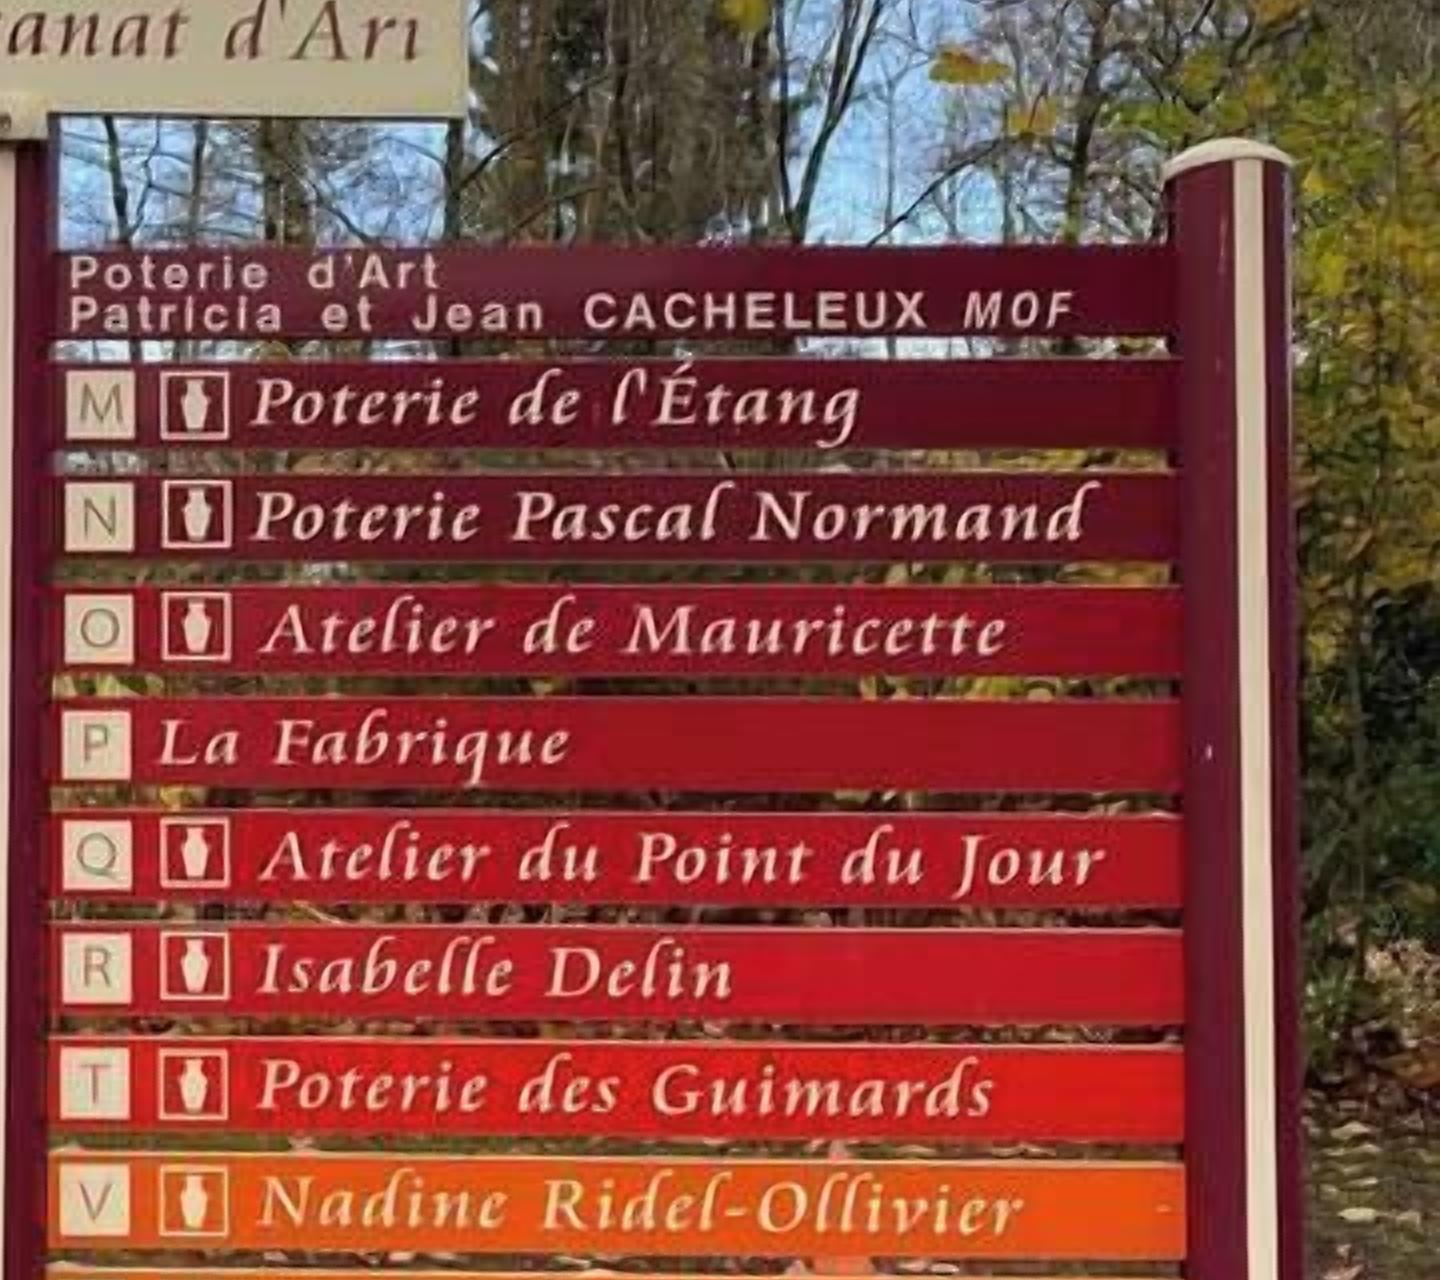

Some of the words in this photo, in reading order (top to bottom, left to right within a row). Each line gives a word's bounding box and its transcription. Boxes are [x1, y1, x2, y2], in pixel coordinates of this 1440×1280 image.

[70, 257, 270, 290] Poterie
[308, 256, 439, 290] d'Art
[70, 295, 282, 333] Patricia
[322, 296, 373, 332] et
[413, 294, 543, 333] Jean
[584, 292, 926, 331] CACHELEUX
[964, 290, 1074, 328] MOF
[79, 382, 124, 423] M
[251, 378, 482, 427] Poterie
[509, 368, 581, 426] de
[611, 360, 859, 449] l'Étang
[83, 497, 117, 537] N
[251, 491, 482, 542] Poterie
[513, 482, 735, 543] Pascal
[749, 481, 1102, 543] Normand
[260, 596, 495, 655] Atelier
[523, 595, 595, 655] de
[621, 604, 1005, 657] Mauricette
[83, 724, 108, 762] P
[157, 719, 239, 766] La
[272, 709, 571, 786] Fabrique
[77, 832, 118, 881] Q
[259, 821, 491, 883] Atelier
[518, 821, 600, 883] du
[632, 832, 814, 884] Point
[840, 823, 924, 885] du
[951, 834, 1106, 900] Jour
[83, 947, 111, 988] R
[257, 935, 513, 996] Isabelle
[544, 936, 732, 999] Delin
[81, 1063, 113, 1104] T
[258, 1058, 487, 1112] Poterie
[517, 1053, 619, 1113] des
[653, 1056, 995, 1117] Guimards
[79, 1183, 112, 1221] V
[258, 1167, 509, 1228] Nadine
[543, 1169, 1026, 1235] Ridel-Ollivier
